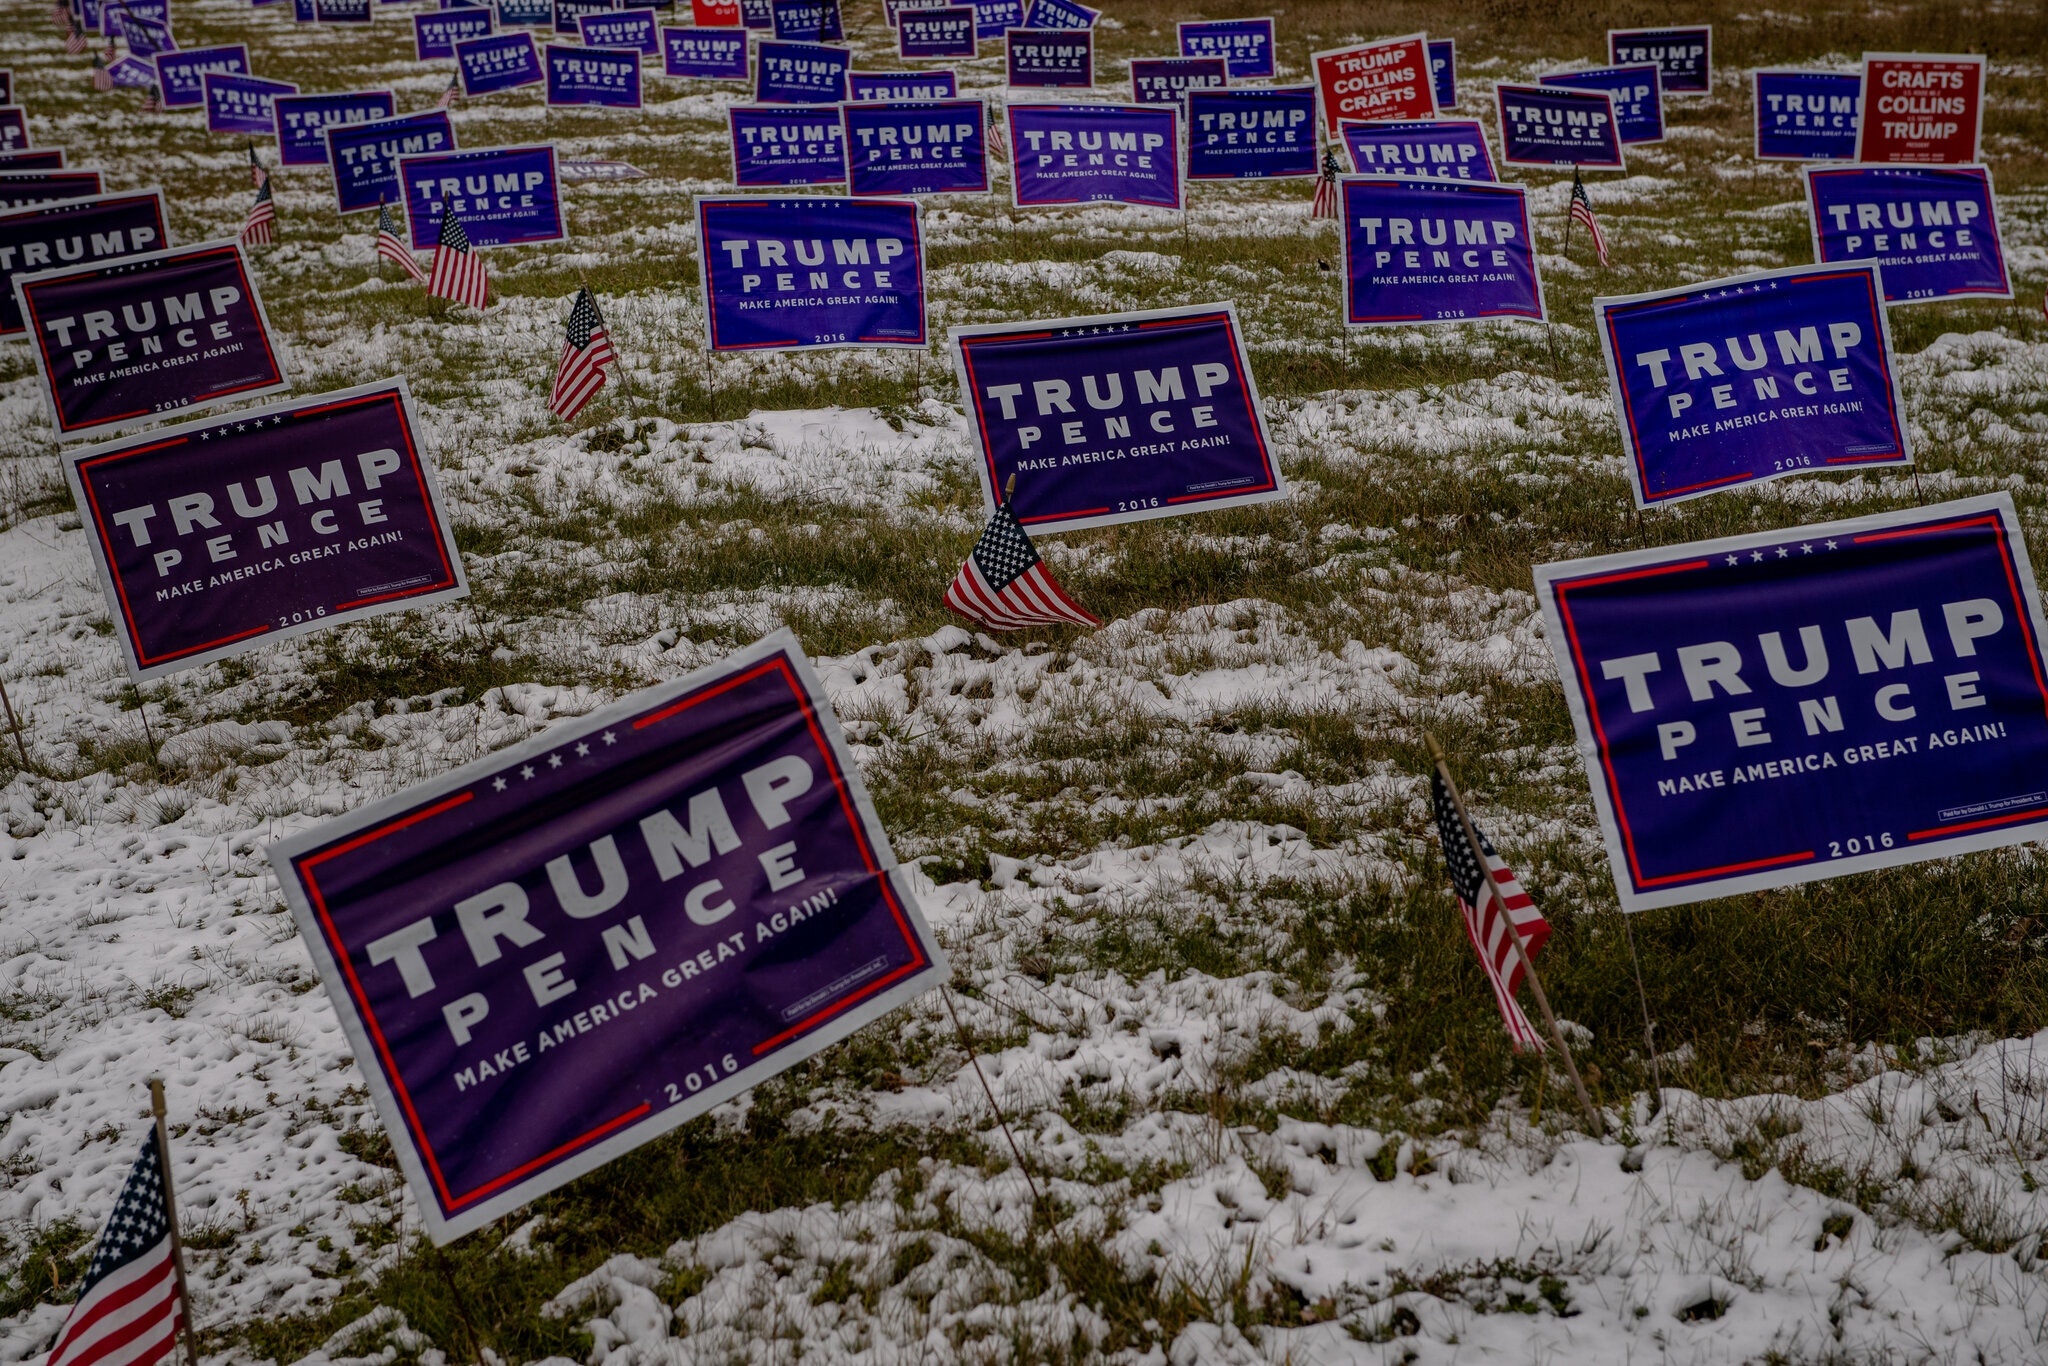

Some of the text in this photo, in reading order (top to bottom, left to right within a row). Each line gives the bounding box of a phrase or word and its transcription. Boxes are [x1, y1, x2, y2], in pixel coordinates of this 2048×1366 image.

[421, 20, 487, 35] TRUMP
[586, 21, 651, 37] TRUMP
[903, 21, 970, 33] TRUMP
[909, 32, 963, 40] PENCE
[593, 32, 646, 44] PENCE
[670, 39, 742, 52] TRUMP
[1187, 34, 1266, 50] TRUMP
[464, 45, 531, 67] TRUMP
[677, 51, 735, 61] PENCE
[1012, 46, 1087, 57] TRUMP
[1335, 49, 1407, 74] TRUMP
[1616, 45, 1704, 61] TRUMP
[472, 58, 527, 75] PENCE
[553, 60, 632, 75] TRUMP
[764, 57, 842, 76] TRUMP
[561, 74, 625, 85] PENCE
[770, 72, 834, 86] PENCE
[1137, 75, 1222, 90] TRUMP
[1333, 67, 1417, 95] COLLINS
[1881, 69, 1965, 89] CRAFTS
[859, 86, 949, 99] TRUMP
[1339, 86, 1417, 113] CRAFTS
[1877, 95, 1966, 115] COLLINS
[285, 107, 385, 129] TRUMP
[1199, 110, 1305, 131] TRUMP
[1506, 106, 1607, 127] TRUMP
[741, 125, 842, 144] TRUMP
[857, 125, 973, 146] TRUMP
[1208, 131, 1296, 145] PENCE
[1517, 125, 1600, 138] PENCE
[1881, 121, 1959, 140] TRUMP
[340, 131, 443, 165] TRUMP
[752, 143, 835, 157] PENCE
[1024, 131, 1163, 152] TRUMP
[869, 146, 962, 161] PENCE
[1039, 155, 1152, 168] PENCE
[1358, 144, 1477, 164] TRUMP
[416, 172, 543, 199] TRUMP
[431, 195, 533, 214] PENCE
[457, 214, 485, 223] MERICA
[1828, 201, 1979, 230] TRUMP
[1360, 218, 1515, 245] TRUMP
[1847, 230, 1972, 252] PENCE
[722, 239, 903, 268] TRUMP
[1376, 250, 1508, 268] PENCE
[1878, 256, 1912, 266] MERICA
[1916, 255, 1941, 263] GREAT
[743, 271, 892, 292] PENCE
[1373, 276, 1398, 284] MAKE
[1402, 275, 1445, 283] AMERICA
[1483, 273, 1515, 281] AGAIN!
[740, 300, 770, 309] MAKE
[775, 298, 823, 307] AMERICA
[827, 296, 860, 305] GREAT
[1907, 290, 1933, 298] 2016
[46, 286, 240, 347] TRUMP
[73, 321, 232, 368] PENCE
[815, 334, 845, 342] 2016
[74, 343, 243, 386] MAKE AMERICA GREAT AGAIN!
[1636, 322, 1861, 388] TRUMP
[986, 363, 1229, 420] TRUMP
[1668, 368, 1852, 418] PENCE
[156, 398, 188, 411] 2016
[1017, 405, 1218, 449] PENCE
[1670, 401, 1861, 441] MAKE AMERICA GREAT AGAIN!
[1018, 435, 1230, 471] MAKE AMERICA GREAT AGAIN!
[1774, 455, 1811, 471] 2016
[112, 448, 400, 547] TRUMP
[1119, 498, 1158, 511] 2016
[153, 499, 388, 577] PENCE
[156, 531, 402, 601] MAKE AMERICA GREAT AGAIN!
[279, 606, 325, 627] 2016
[1600, 598, 2003, 713] TRUMP
[1657, 671, 1986, 760] PENCE
[1658, 722, 2006, 796] MAKE AMERICA GREAT AGAIN!
[1829, 832, 1893, 857] 2016
[366, 755, 813, 998] TRUMP
[442, 841, 805, 1046] PENCE
[454, 887, 837, 1091] MAKE AMERICA GREAT AGAIN!
[665, 1054, 737, 1103] 2016
